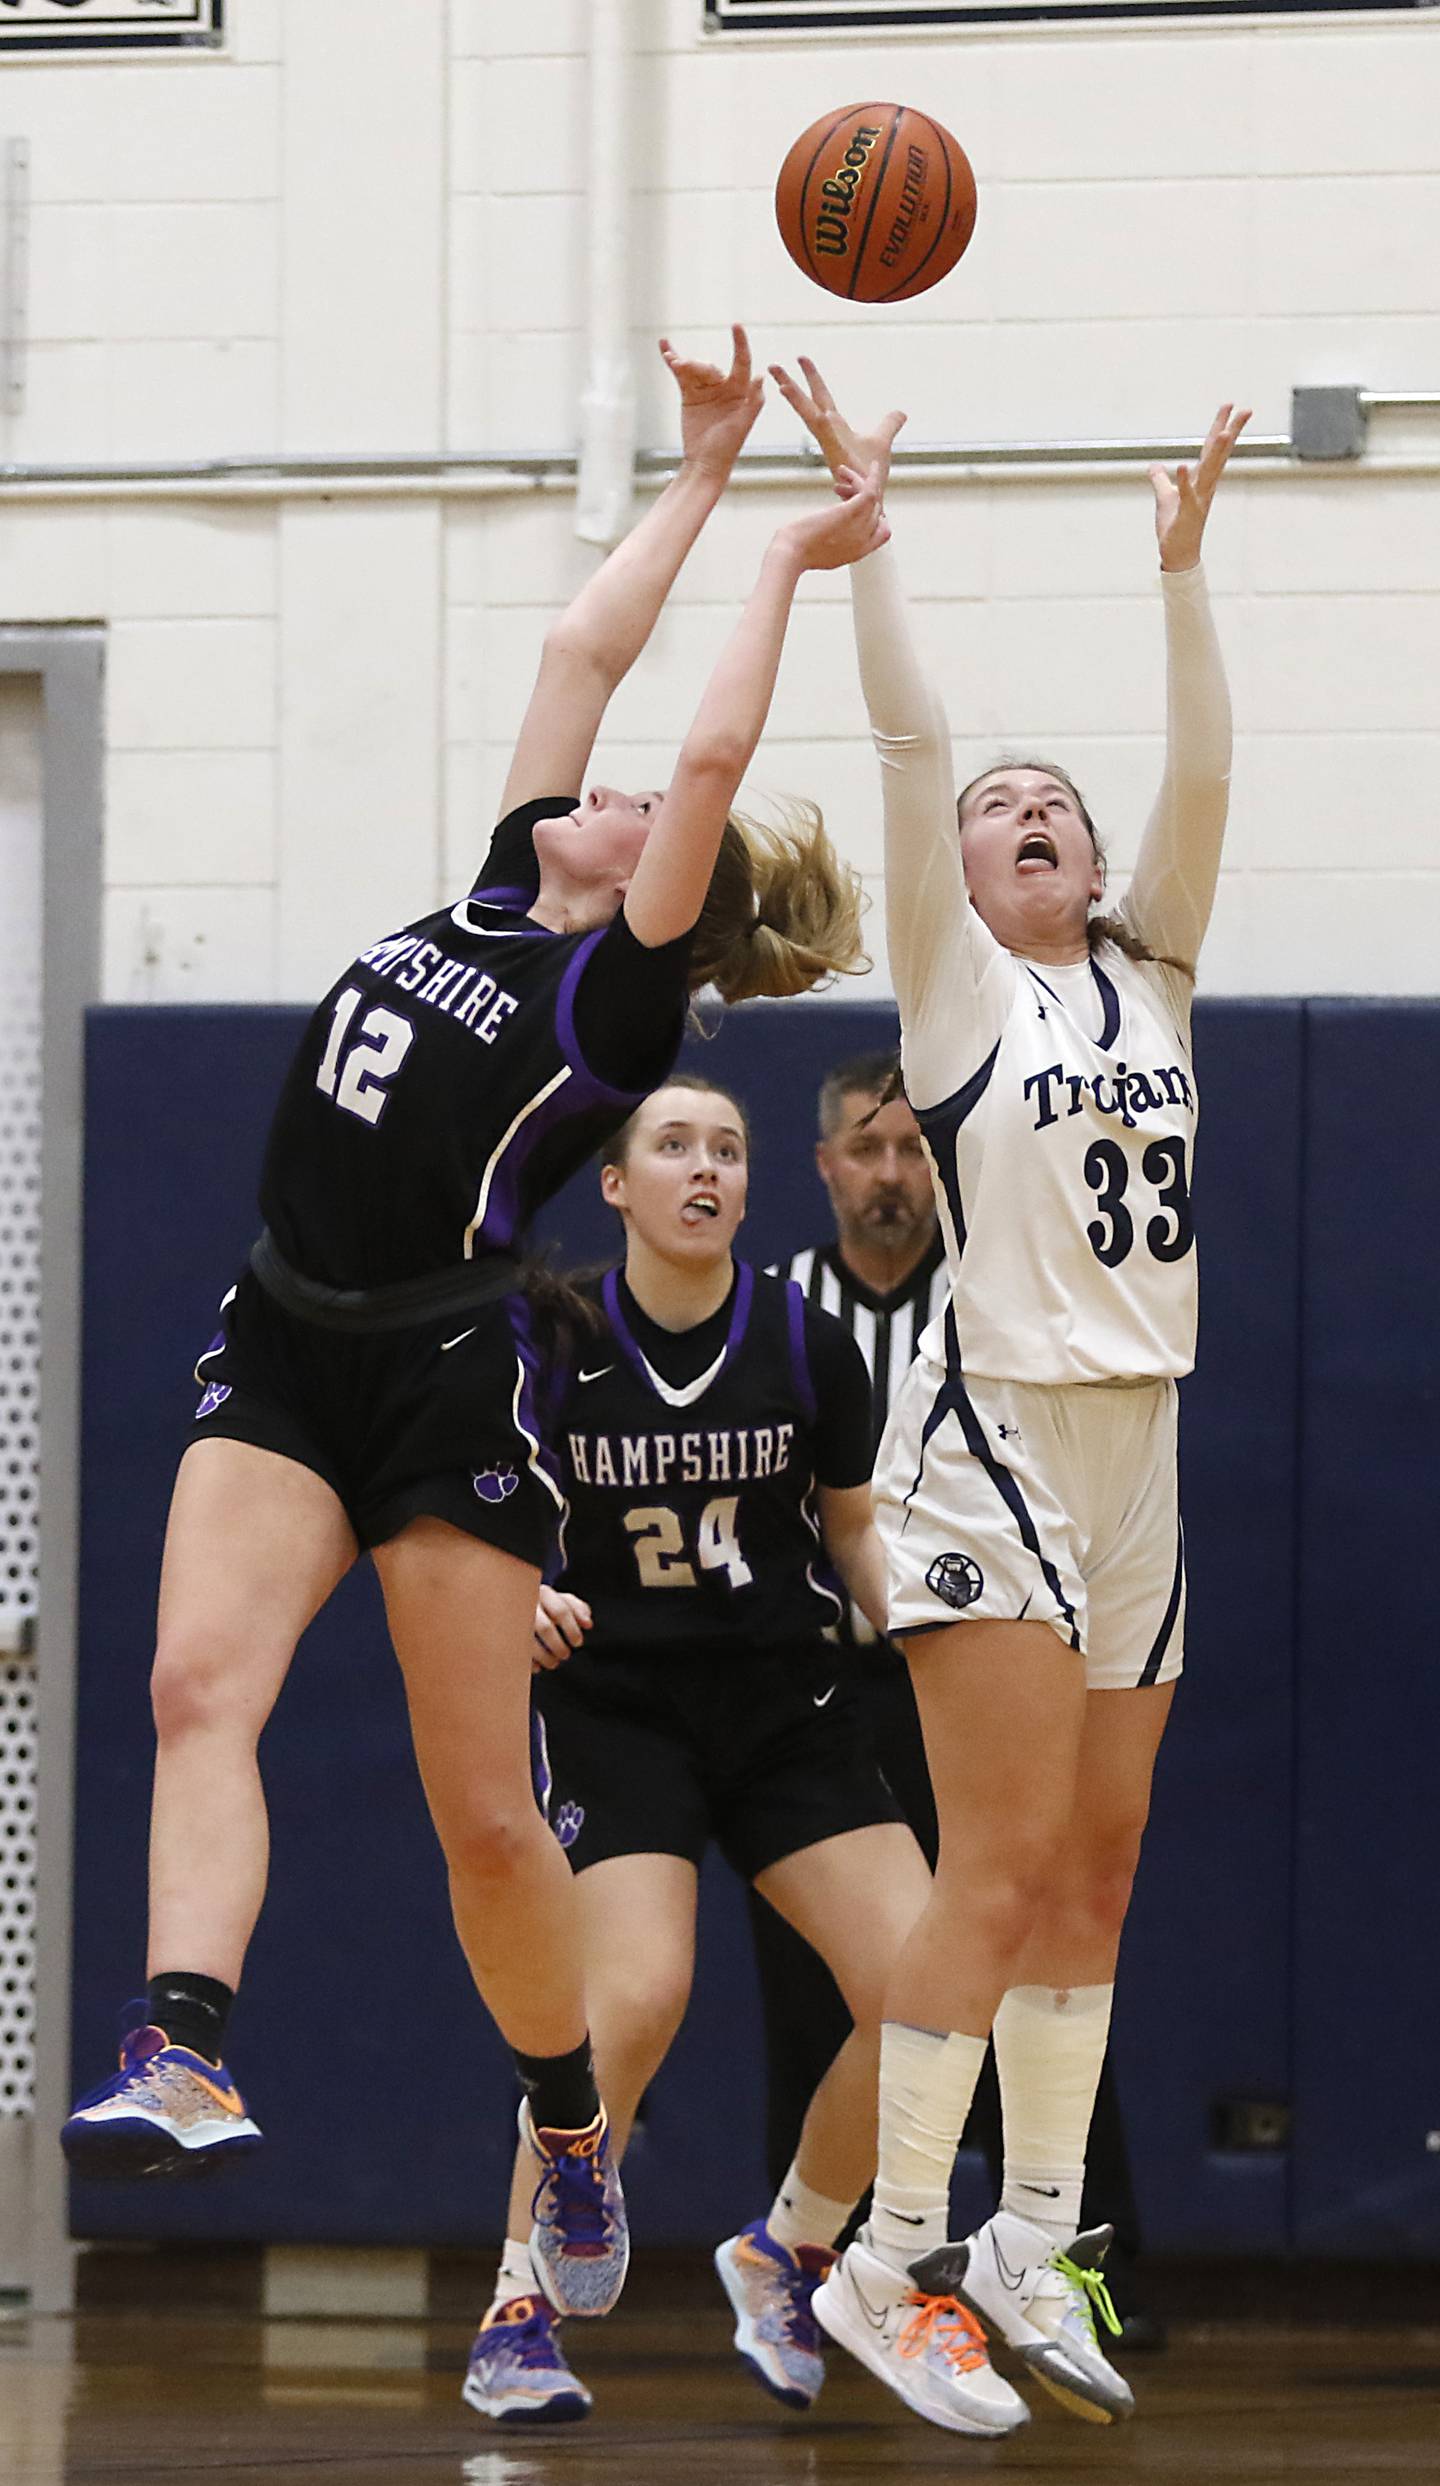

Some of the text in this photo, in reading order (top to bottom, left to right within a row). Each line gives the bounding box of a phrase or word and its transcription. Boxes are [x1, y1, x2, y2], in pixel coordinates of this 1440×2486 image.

[816, 124, 883, 257] Wilson
[879, 143, 925, 268] EVOLUTION
[315, 986, 415, 1126] 12
[1083, 1135, 1194, 1269] 33
[567, 1423, 795, 1488] HAMPSHIRE
[622, 1495, 754, 1589] 24
